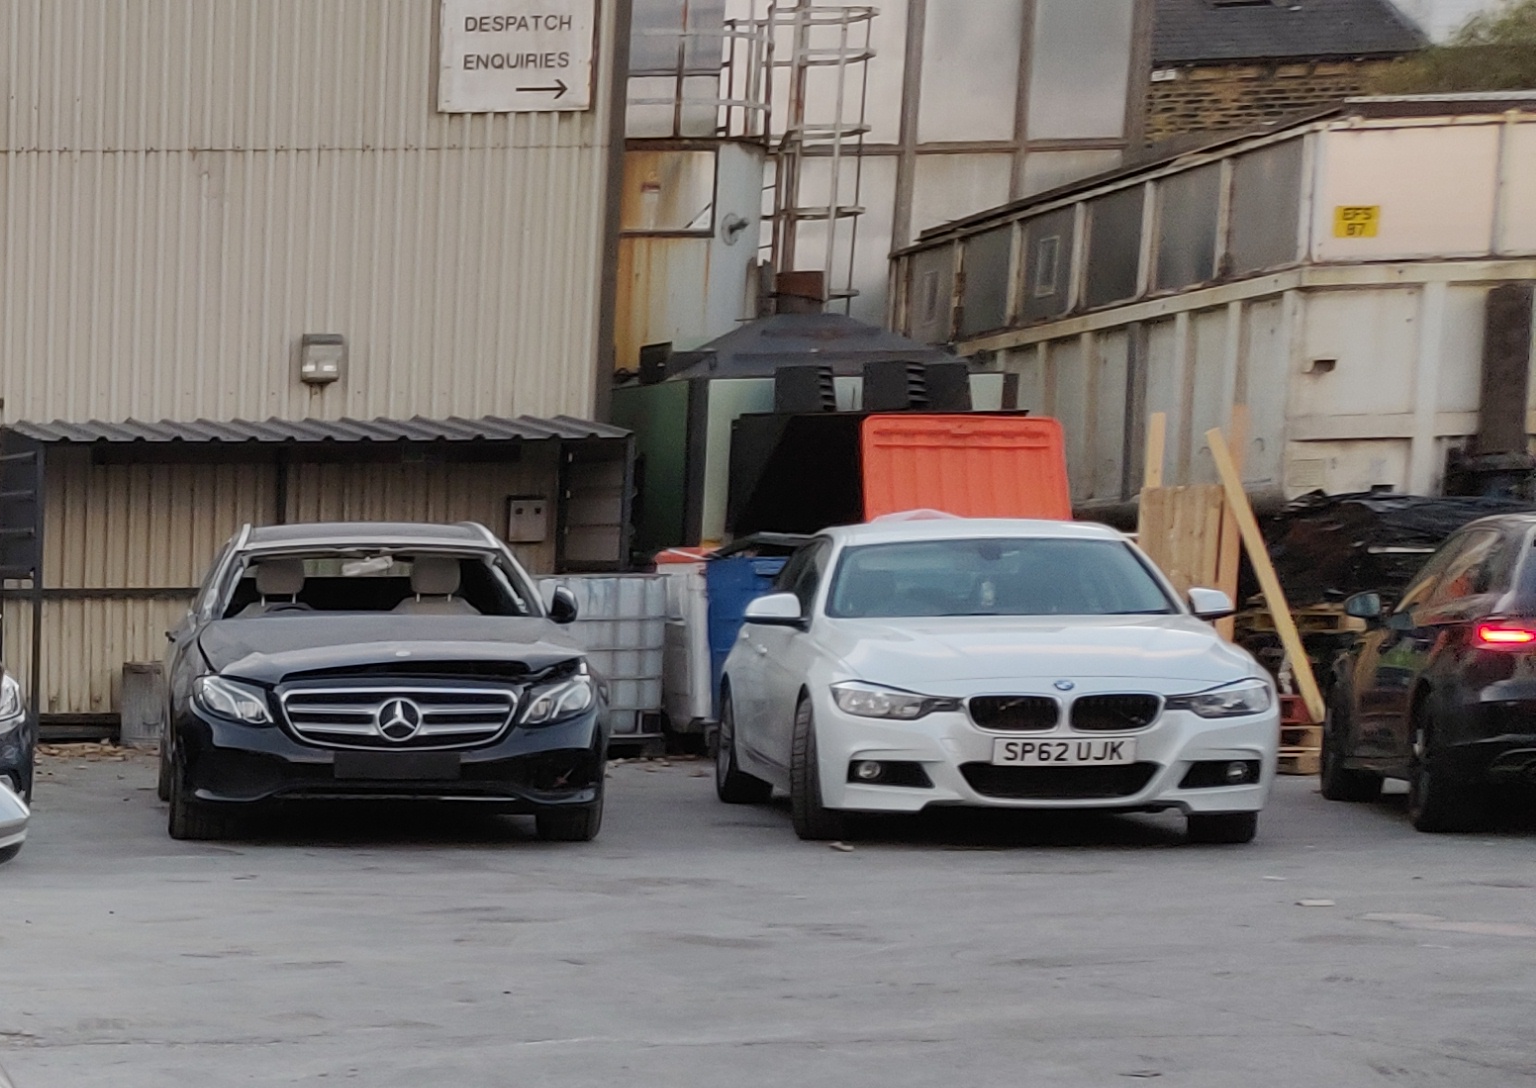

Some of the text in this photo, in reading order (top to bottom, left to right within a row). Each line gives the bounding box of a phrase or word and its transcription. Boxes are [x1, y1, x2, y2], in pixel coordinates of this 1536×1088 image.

[464, 14, 573, 32] DESPATCH
[463, 51, 570, 71] ENQUIRIES
[1003, 740, 1125, 762] SP62 UJK
